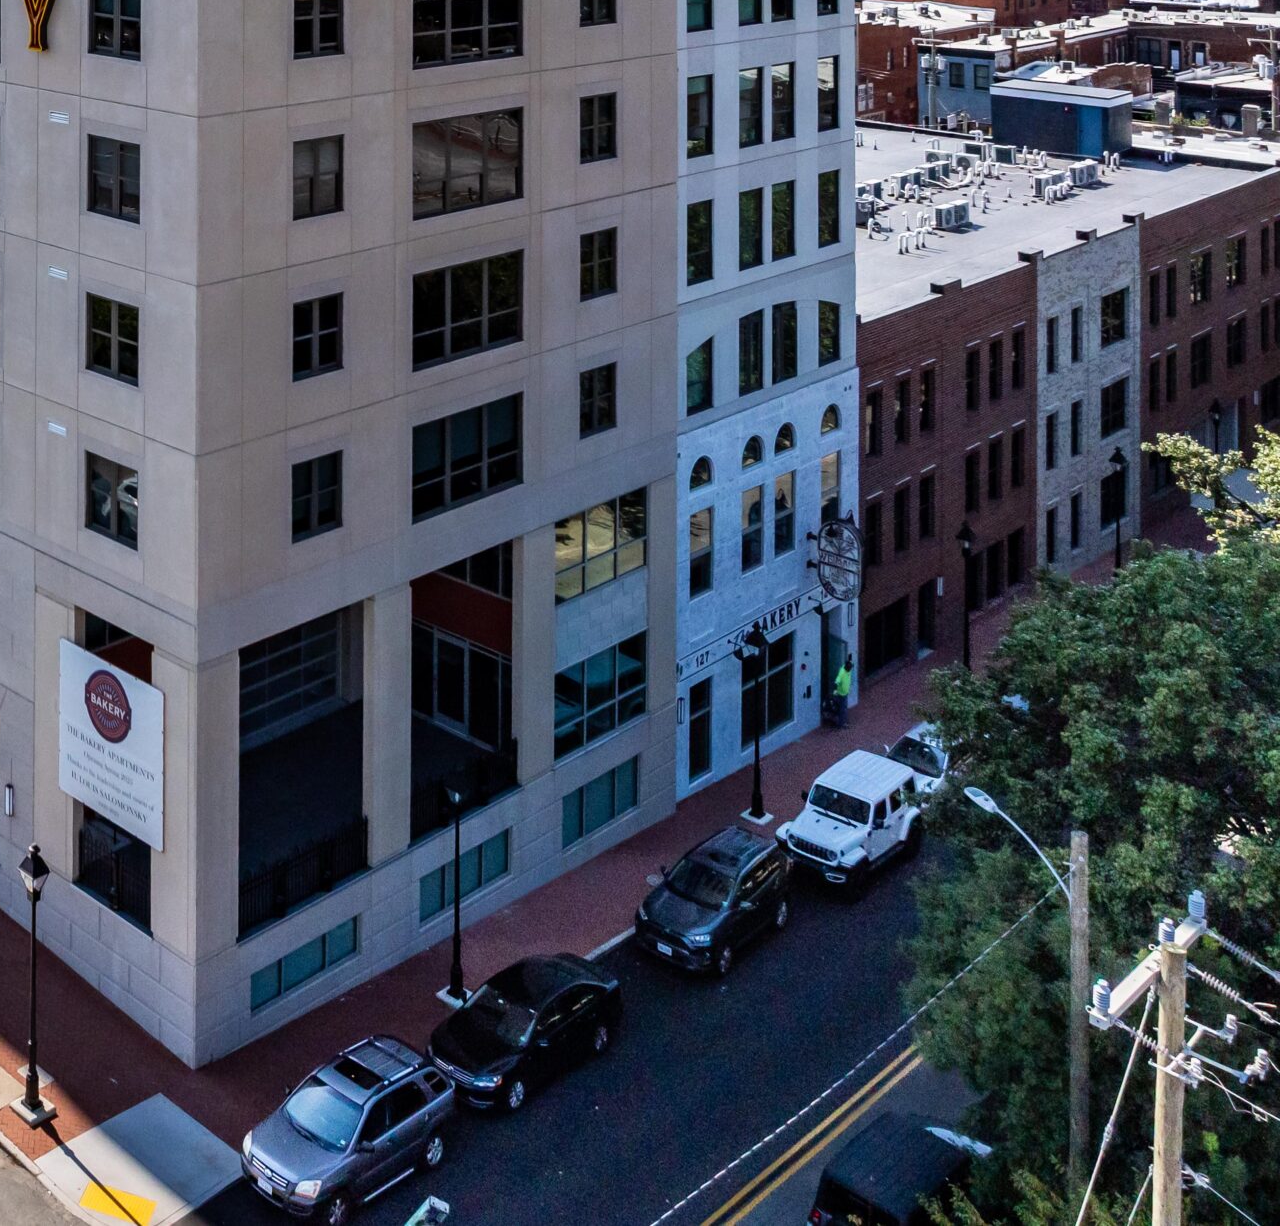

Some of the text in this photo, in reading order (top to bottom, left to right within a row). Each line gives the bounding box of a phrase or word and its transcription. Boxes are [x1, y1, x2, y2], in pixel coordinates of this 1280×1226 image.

[695, 650, 710, 668] 127
[757, 598, 801, 632] AKERY
[90, 692, 126, 720] BAKERY
[80, 731, 106, 755] BAKERY
[108, 750, 154, 782] APARTMENTS
